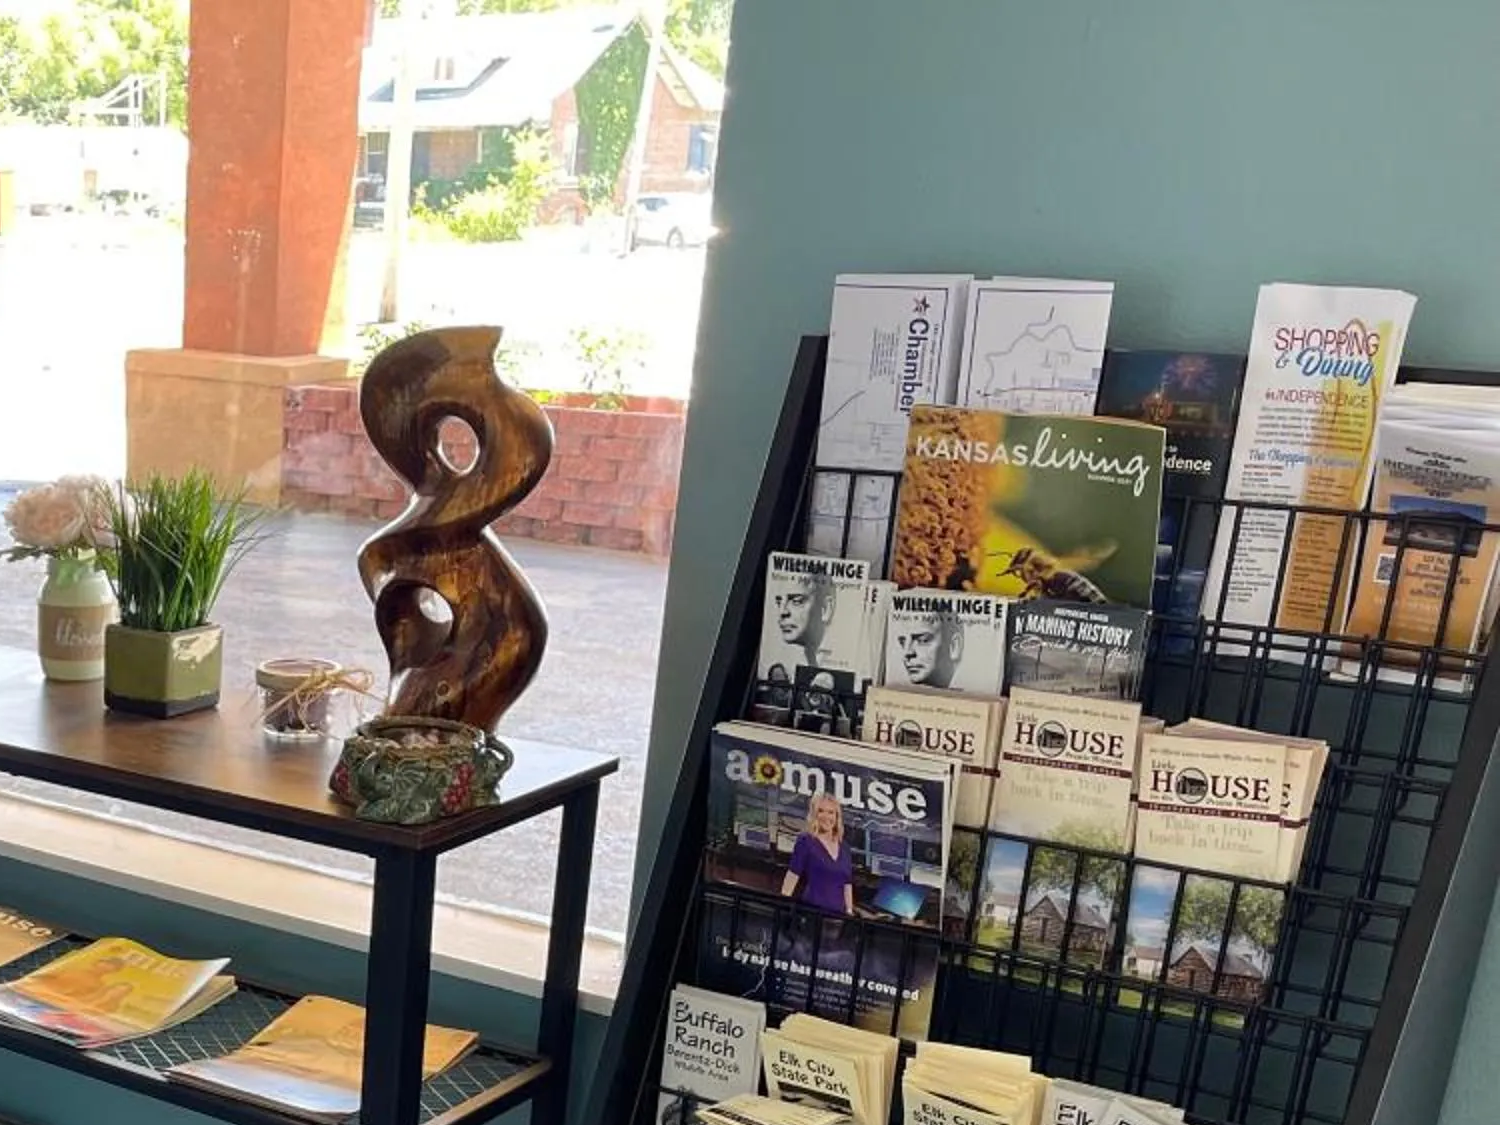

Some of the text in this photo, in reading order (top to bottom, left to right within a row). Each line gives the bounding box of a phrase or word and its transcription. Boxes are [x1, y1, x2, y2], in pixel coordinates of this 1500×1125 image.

[1275, 327, 1380, 357] SHOPPING
[1296, 347, 1375, 387] Dining
[915, 427, 1151, 497] KANSAS living
[772, 555, 866, 580] WILLIAM INGE
[892, 596, 954, 614] WILLIAM
[956, 599, 992, 616] INGE
[1025, 613, 1077, 639] MAKING
[1077, 621, 1134, 648] HISTORY
[875, 720, 976, 755] HOUSE
[1014, 720, 1125, 759] HOUSE
[1151, 767, 1272, 803] HOUSE
[814, 966, 864, 988] weathr
[866, 980, 920, 1001] coveed
[672, 1000, 745, 1040] Buffalo
[674, 1025, 736, 1059] Ranch
[771, 1061, 850, 1097] State Park
[778, 1049, 836, 1077] Elk City
[921, 1102, 948, 1122] Elk
